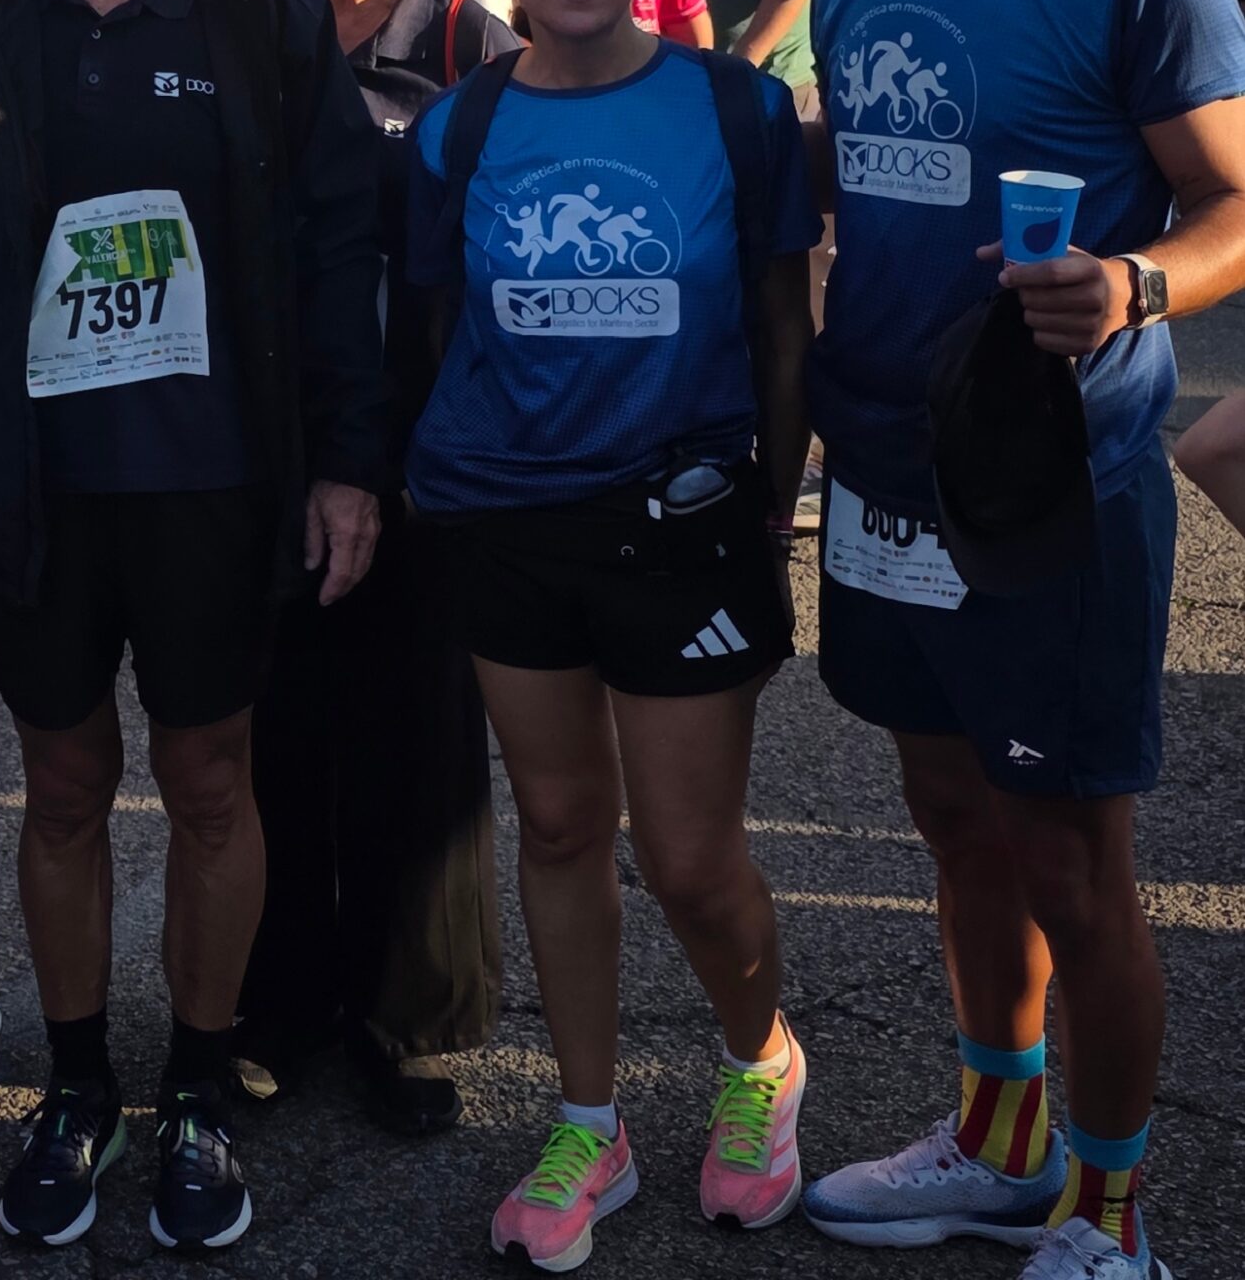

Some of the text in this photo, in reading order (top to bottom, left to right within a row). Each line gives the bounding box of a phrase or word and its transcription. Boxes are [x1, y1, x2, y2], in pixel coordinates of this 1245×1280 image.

[904, 3, 966, 44] movimiento
[186, 78, 215, 95] DOC
[508, 157, 659, 195] Logística en movimiento
[866, 143, 951, 181] DOCKS
[57, 277, 168, 340] 7397
[551, 286, 660, 315] DOCKS
